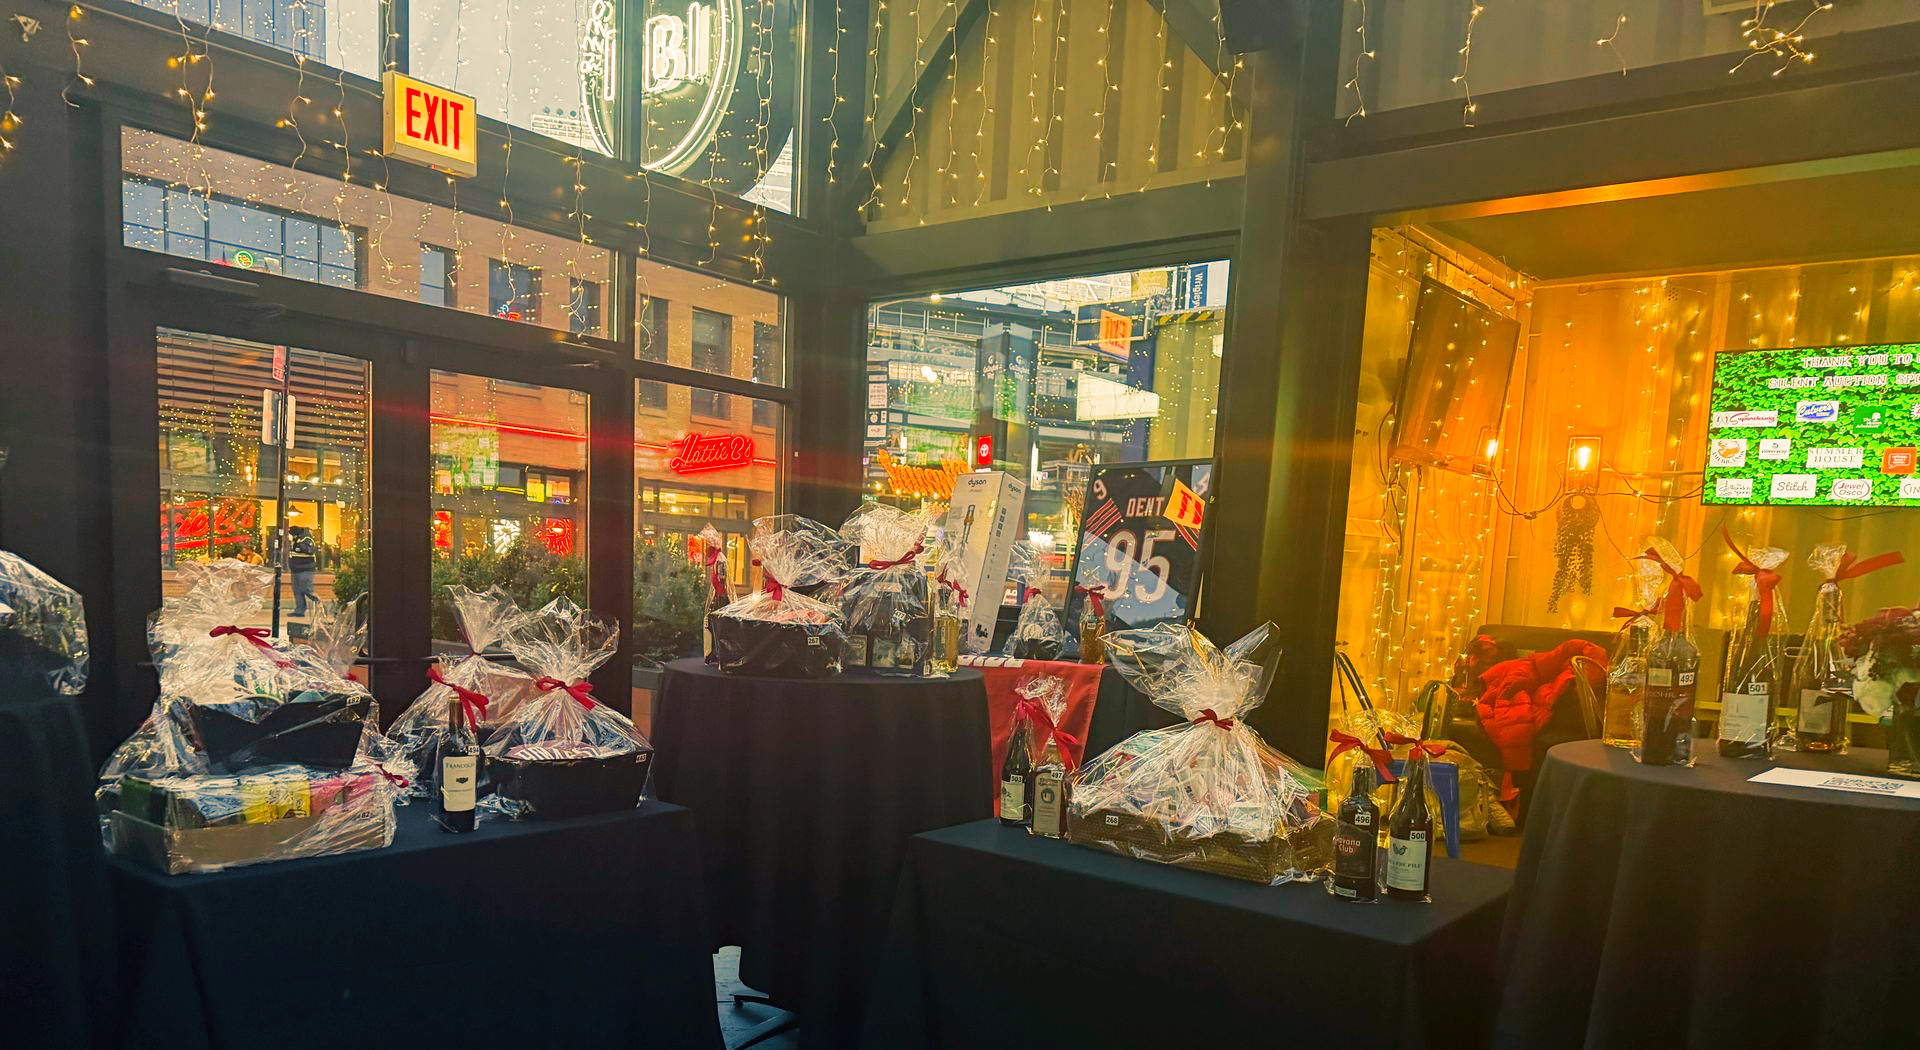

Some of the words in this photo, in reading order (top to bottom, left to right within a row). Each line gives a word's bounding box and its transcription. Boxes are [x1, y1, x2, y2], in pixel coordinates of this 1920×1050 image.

[406, 87, 463, 150] EXIT
[1801, 356, 1852, 368] THANK
[1856, 354, 1888, 366] YOU
[1894, 354, 1913, 365] TO
[1768, 377, 1819, 389] SILENT
[1823, 374, 1887, 387] AUCTION
[1093, 479, 1107, 500] 9
[1777, 481, 1808, 492] Stitch
[1125, 497, 1165, 517] DENT
[1104, 529, 1177, 601] 95
[1750, 684, 1766, 692] 501
[1355, 815, 1370, 824] 496
[1411, 832, 1425, 840] 500
